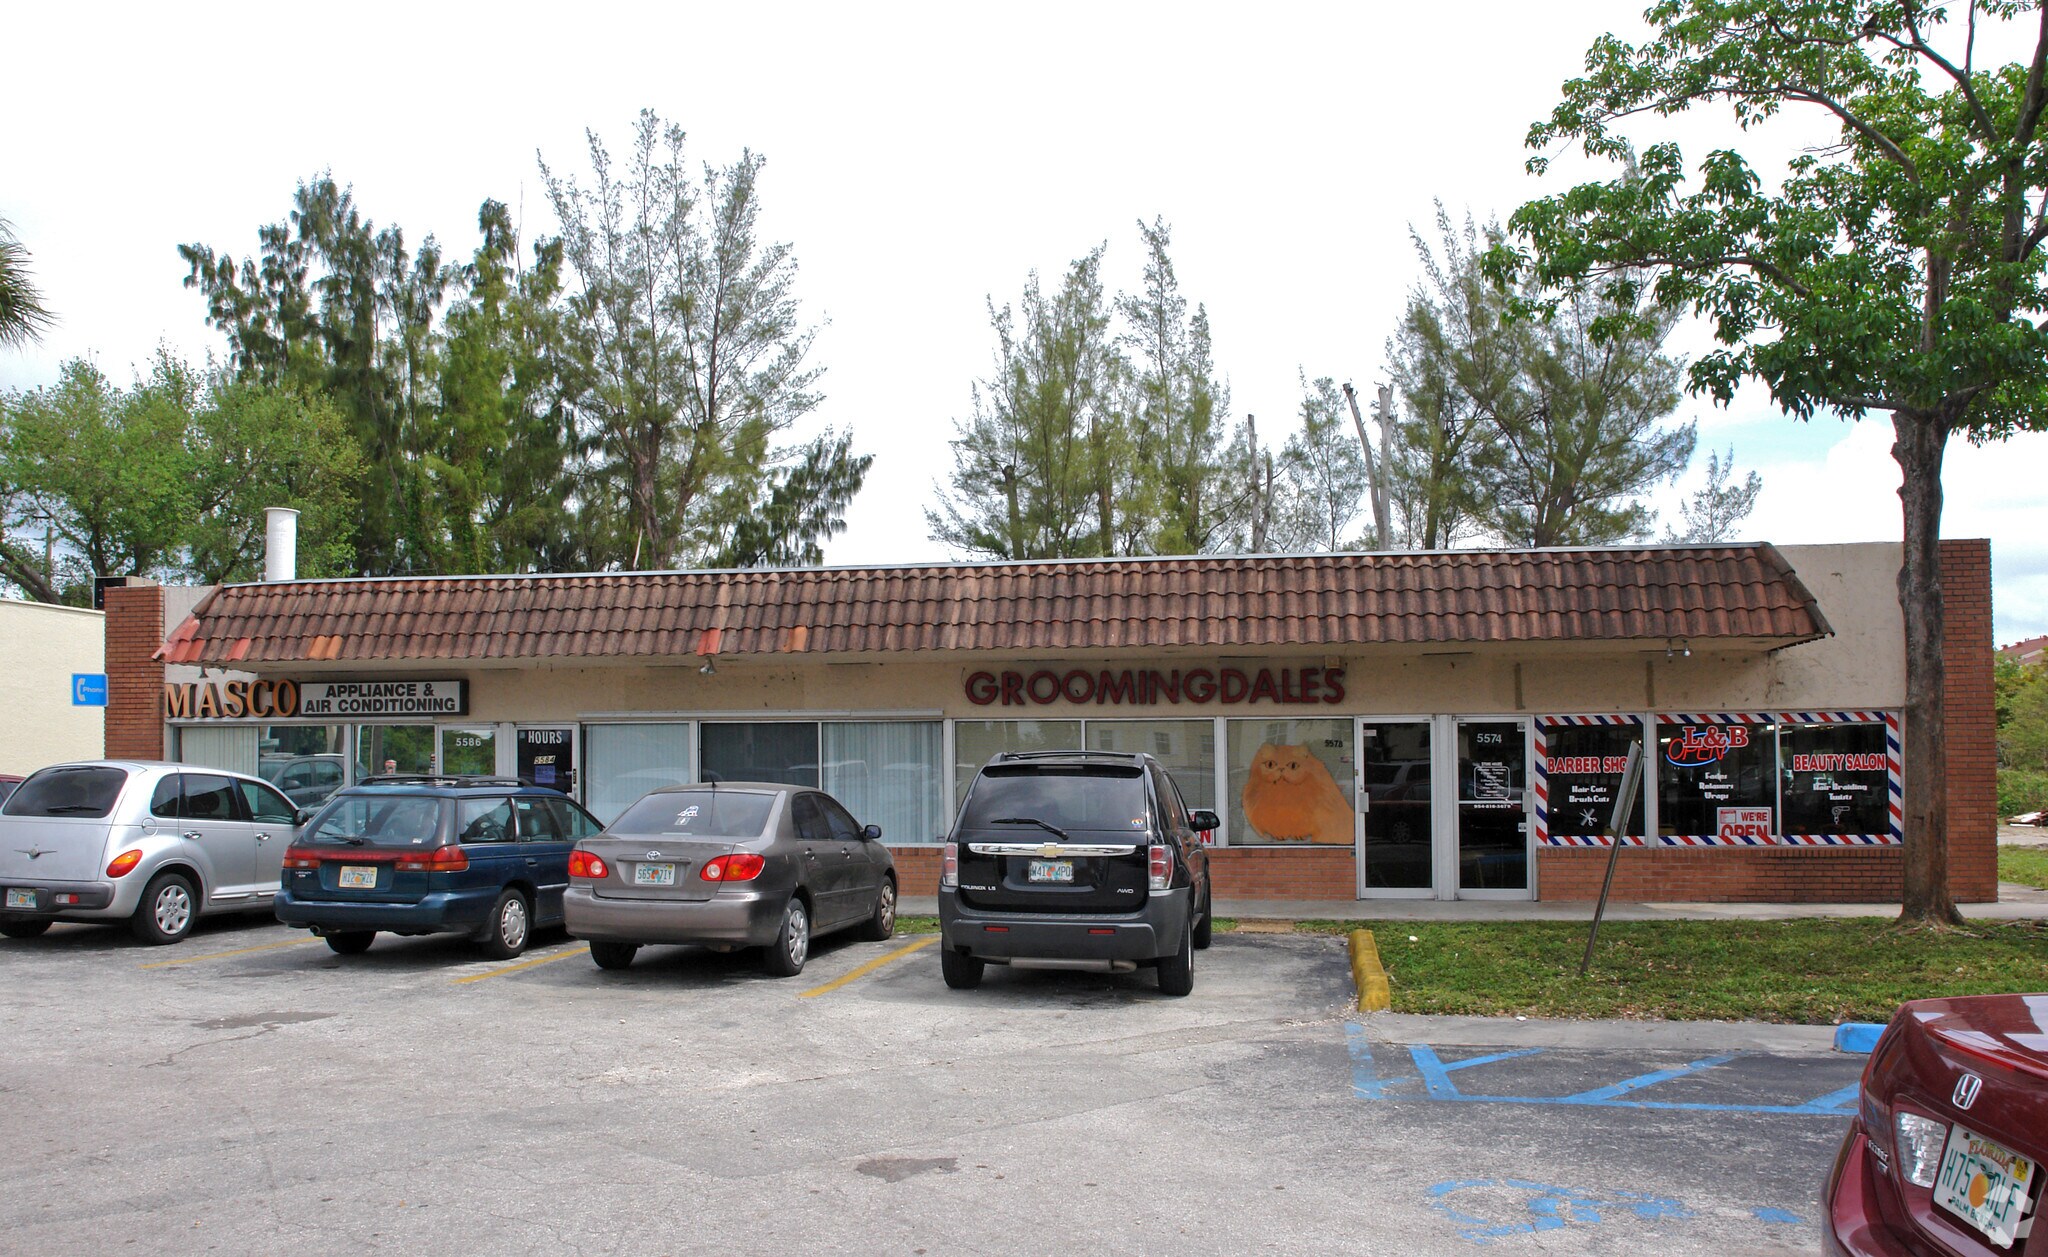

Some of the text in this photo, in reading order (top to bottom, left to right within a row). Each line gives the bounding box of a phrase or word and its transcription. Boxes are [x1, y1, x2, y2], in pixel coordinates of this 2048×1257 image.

[325, 682, 435, 698] APPLIANCE &
[964, 668, 1346, 706] GROOMINGDALES
[165, 678, 300, 718] MASCO
[305, 697, 456, 713] AIR CONDITIONING
[455, 737, 482, 747] 5586
[528, 730, 562, 744] HOURS
[1324, 739, 1344, 748] 5578
[1476, 733, 1502, 743] 5574
[1682, 725, 1749, 748] L&B
[1547, 756, 1628, 774] BARBER SHO
[1793, 753, 1887, 772] BEAUTY SALON
[1571, 785, 1607, 793] Hair Cuts
[1568, 795, 1610, 803] Brush Cuts
[1740, 811, 1768, 822] WE'RE
[1968, 1139, 2012, 1174] FLORIDA
[1942, 1148, 1975, 1197] H75
[1951, 1196, 1969, 1214] PALM
